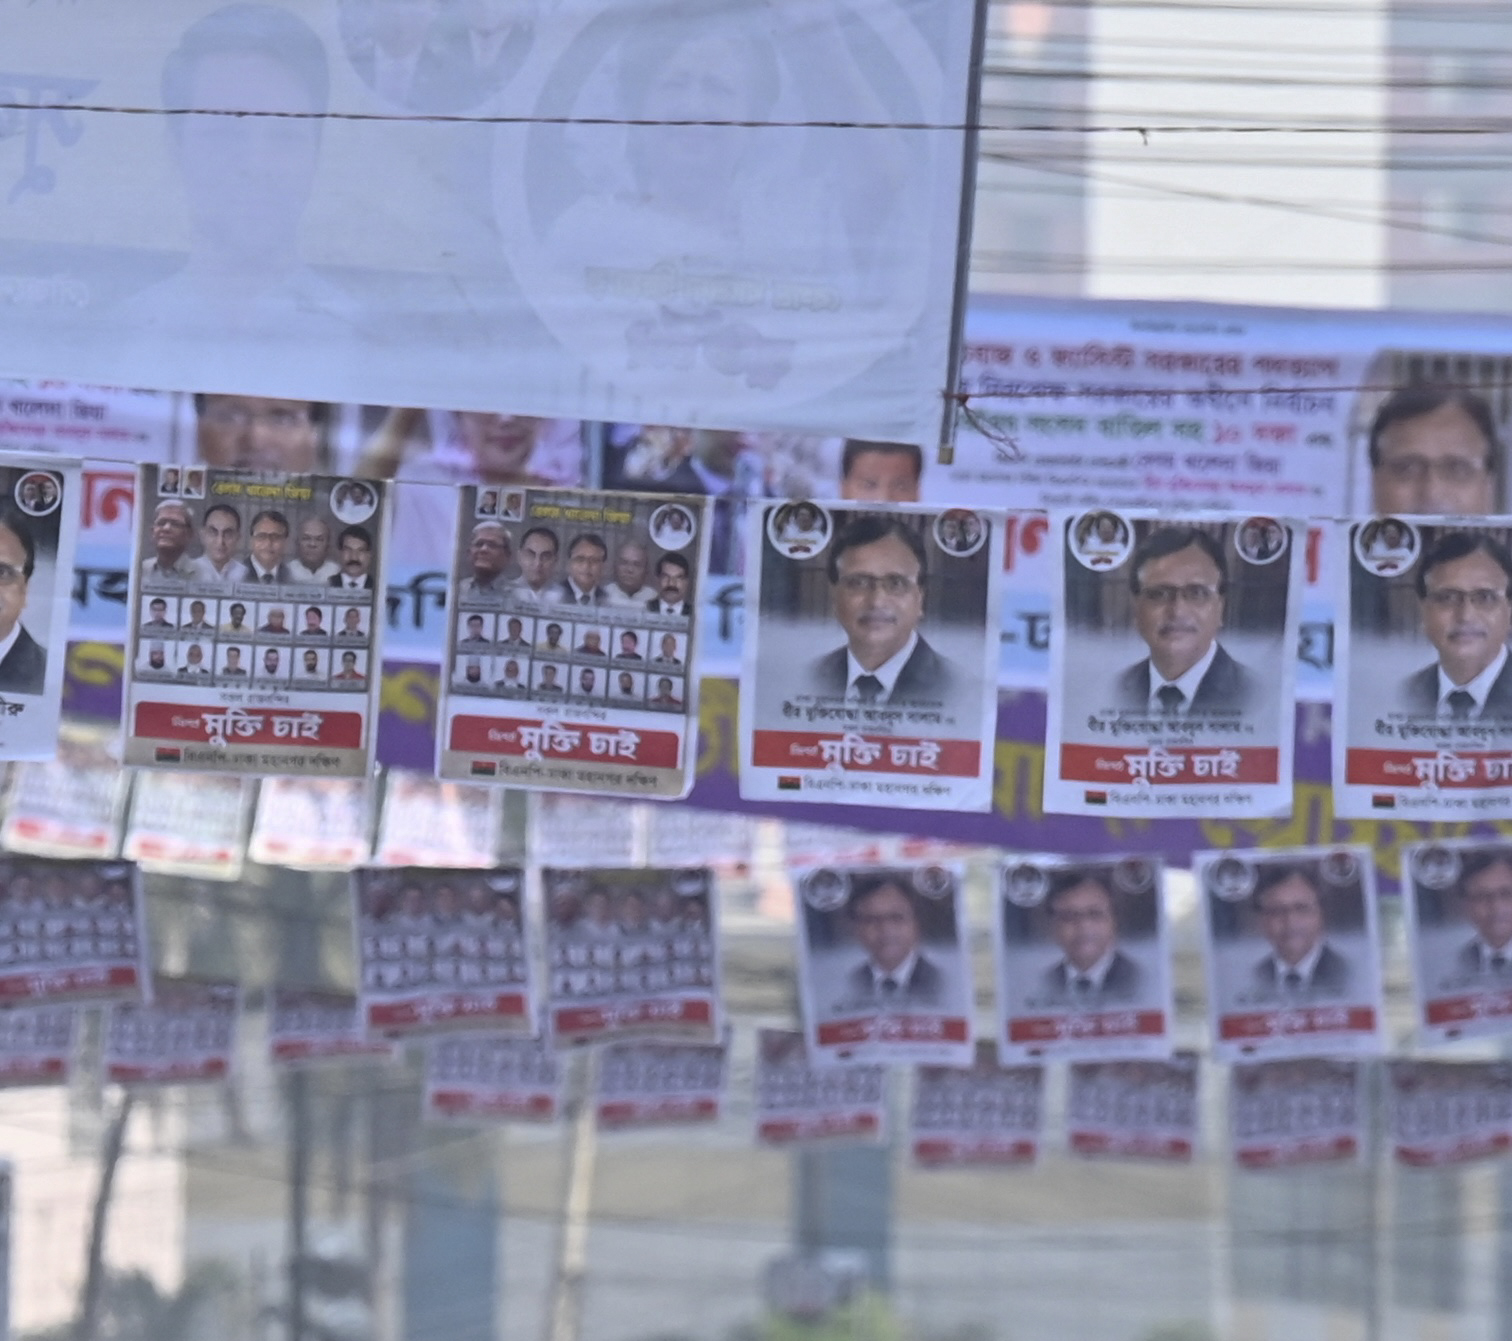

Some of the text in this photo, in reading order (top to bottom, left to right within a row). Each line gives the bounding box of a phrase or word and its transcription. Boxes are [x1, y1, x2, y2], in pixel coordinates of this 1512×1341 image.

[202, 709, 323, 745] মুক্তি চাই
[518, 721, 641, 759] মুক্তি চাই
[818, 731, 941, 776] মুক্তি চাই
[1123, 741, 1240, 786] মুক্তি চাই
[1411, 745, 1473, 792] মুক্তি
